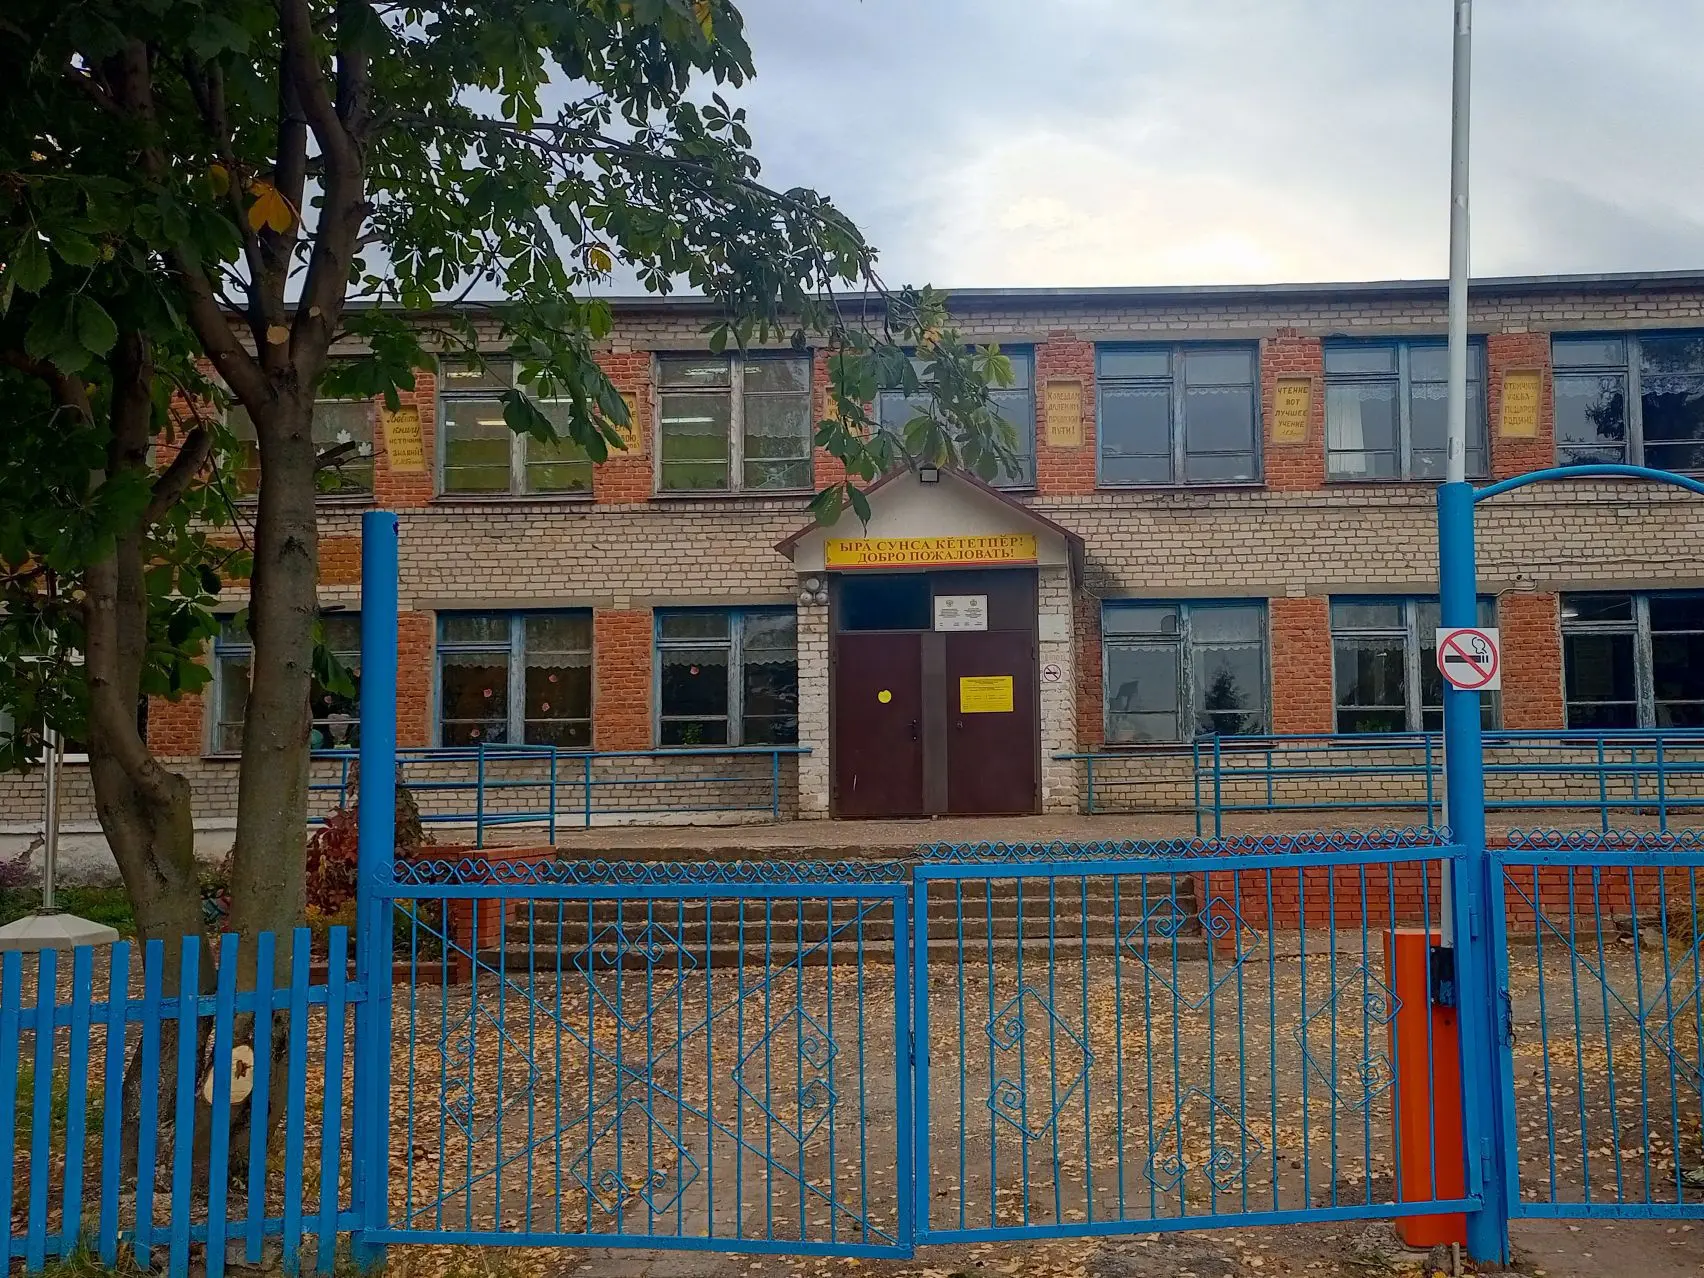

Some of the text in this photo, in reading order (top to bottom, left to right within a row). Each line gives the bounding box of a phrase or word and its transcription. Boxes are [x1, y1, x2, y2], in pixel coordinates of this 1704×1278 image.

[1277, 386, 1309, 394] ЧТЕНИЕ
[1286, 398, 1301, 406] ВОТ
[1275, 409, 1309, 417] ЛУЧШЕЕ
[1278, 420, 1305, 428] УЧЕНИЕ
[1051, 426, 1075, 435] ПУТИ!
[876, 540, 930, 551] СУНСА
[858, 548, 1014, 564] ДОБРО ПОЖАЛОВАТЬ!
